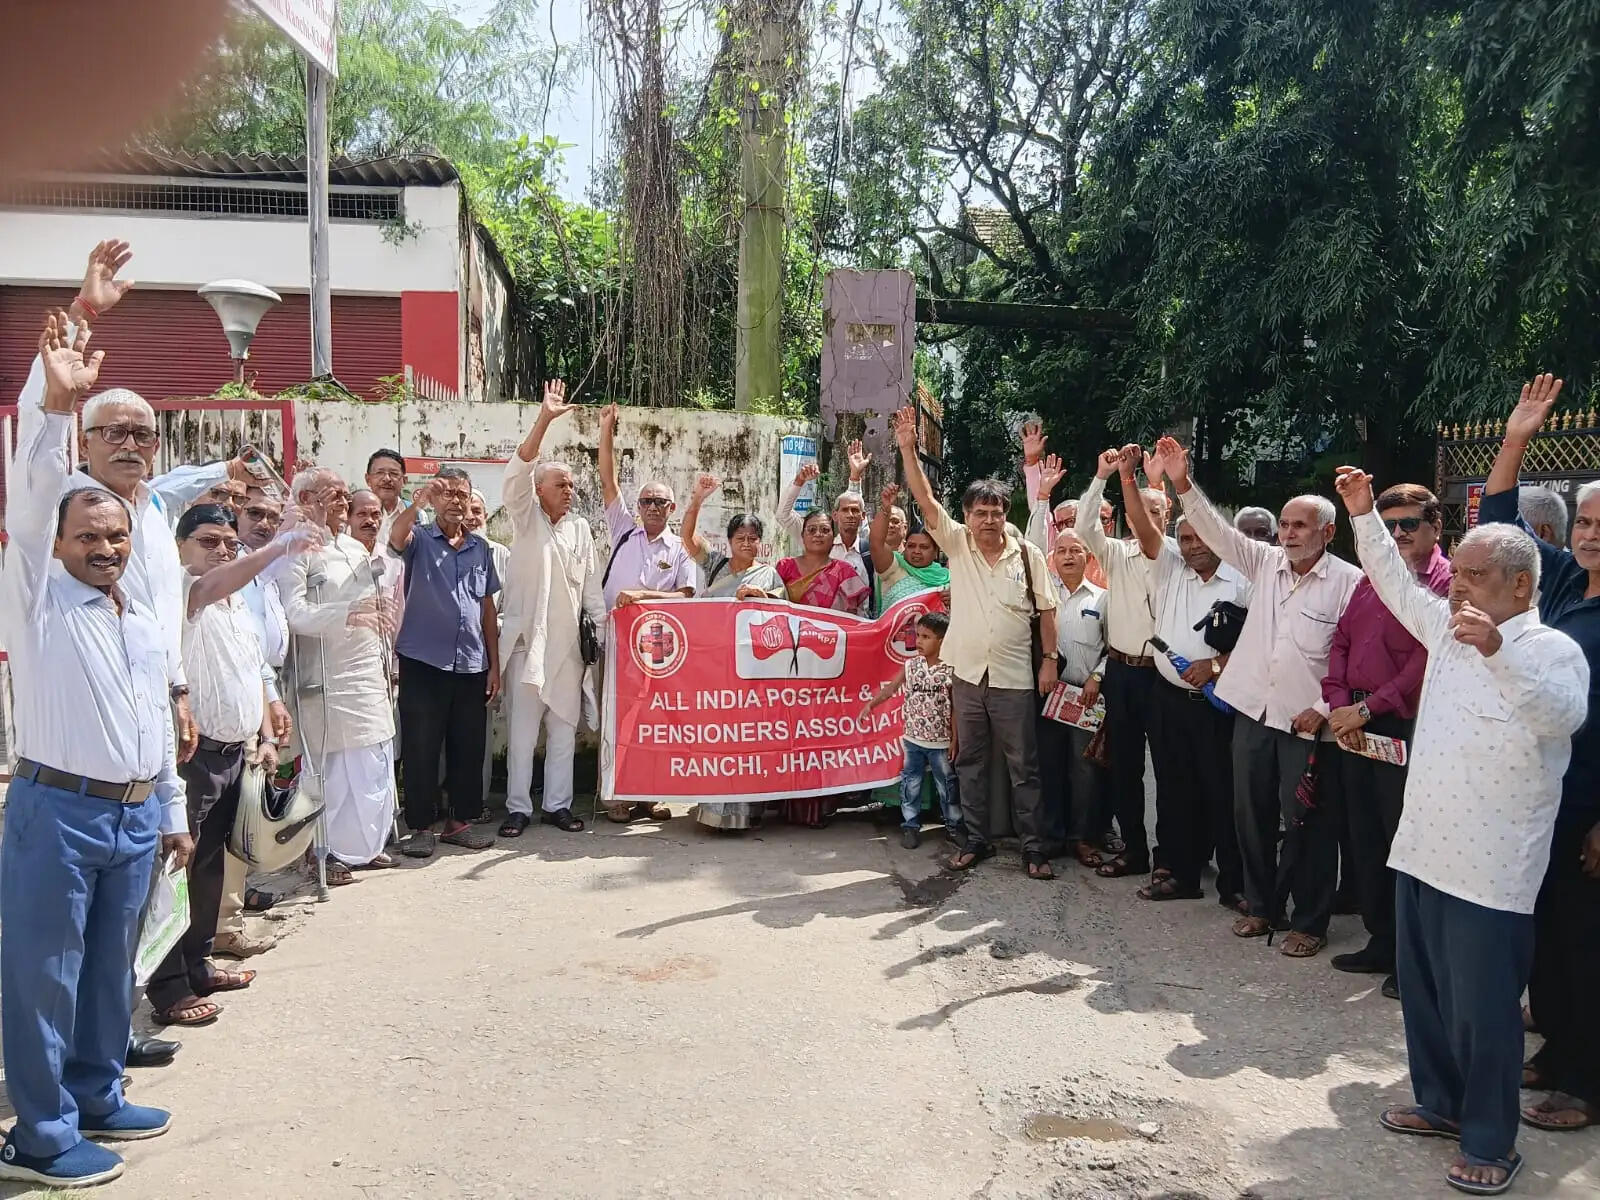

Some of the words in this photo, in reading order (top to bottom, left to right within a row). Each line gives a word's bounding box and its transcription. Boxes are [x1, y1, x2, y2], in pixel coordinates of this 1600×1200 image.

[649, 691, 690, 711] ALL
[696, 689, 762, 710] INDIA
[766, 686, 853, 707] POSTAL
[858, 684, 873, 702] &
[638, 720, 789, 744] PENSIONERS
[795, 704, 905, 739] ASSOCIATI
[670, 755, 768, 778] RANCHI,
